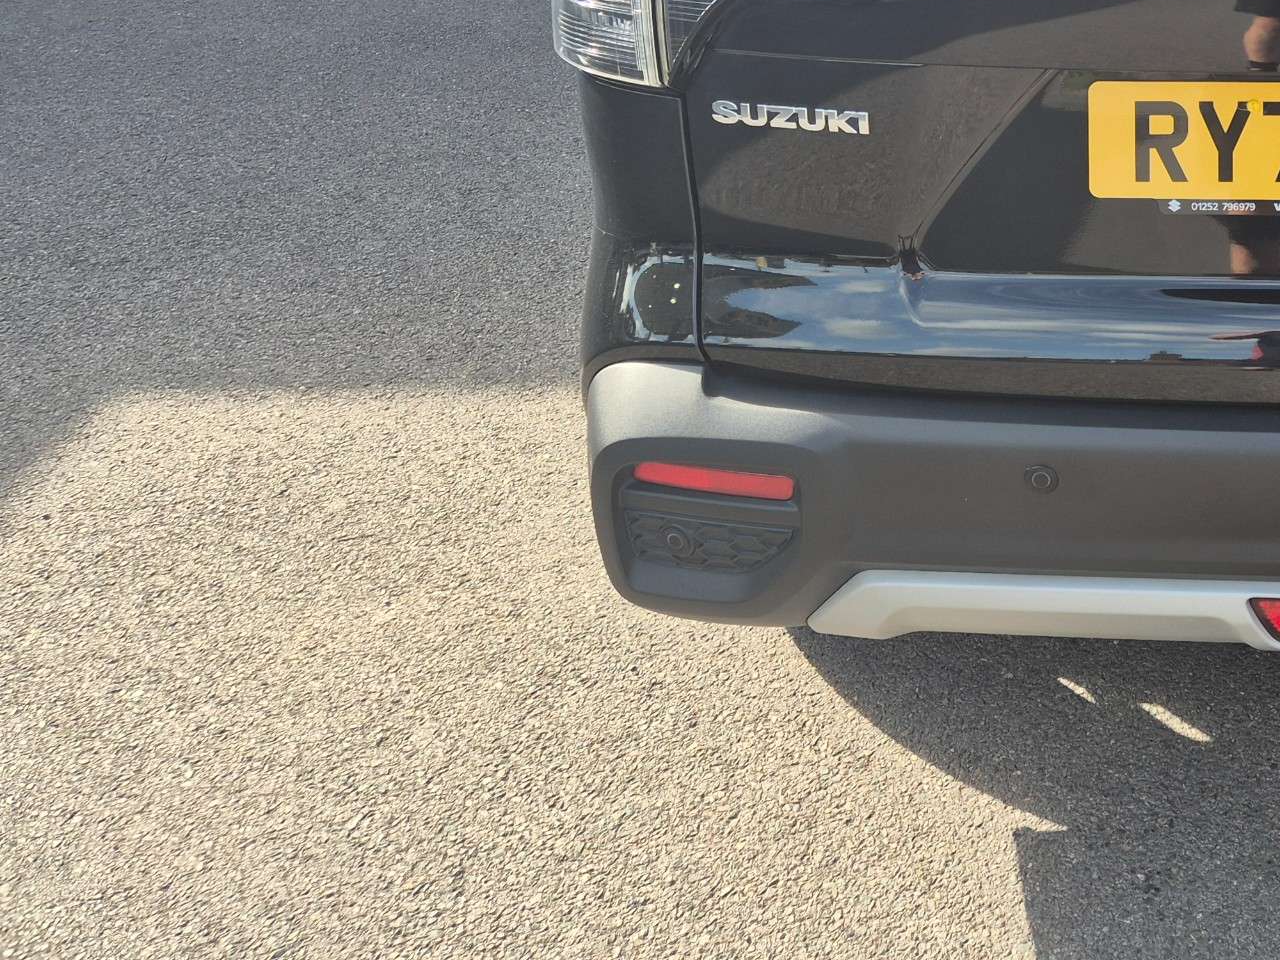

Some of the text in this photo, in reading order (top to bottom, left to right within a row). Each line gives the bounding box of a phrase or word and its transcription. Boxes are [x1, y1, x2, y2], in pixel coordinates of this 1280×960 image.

[711, 100, 870, 135] SUZUKI
[1191, 201, 1219, 212] 01252
[1222, 202, 1256, 212] 796979
